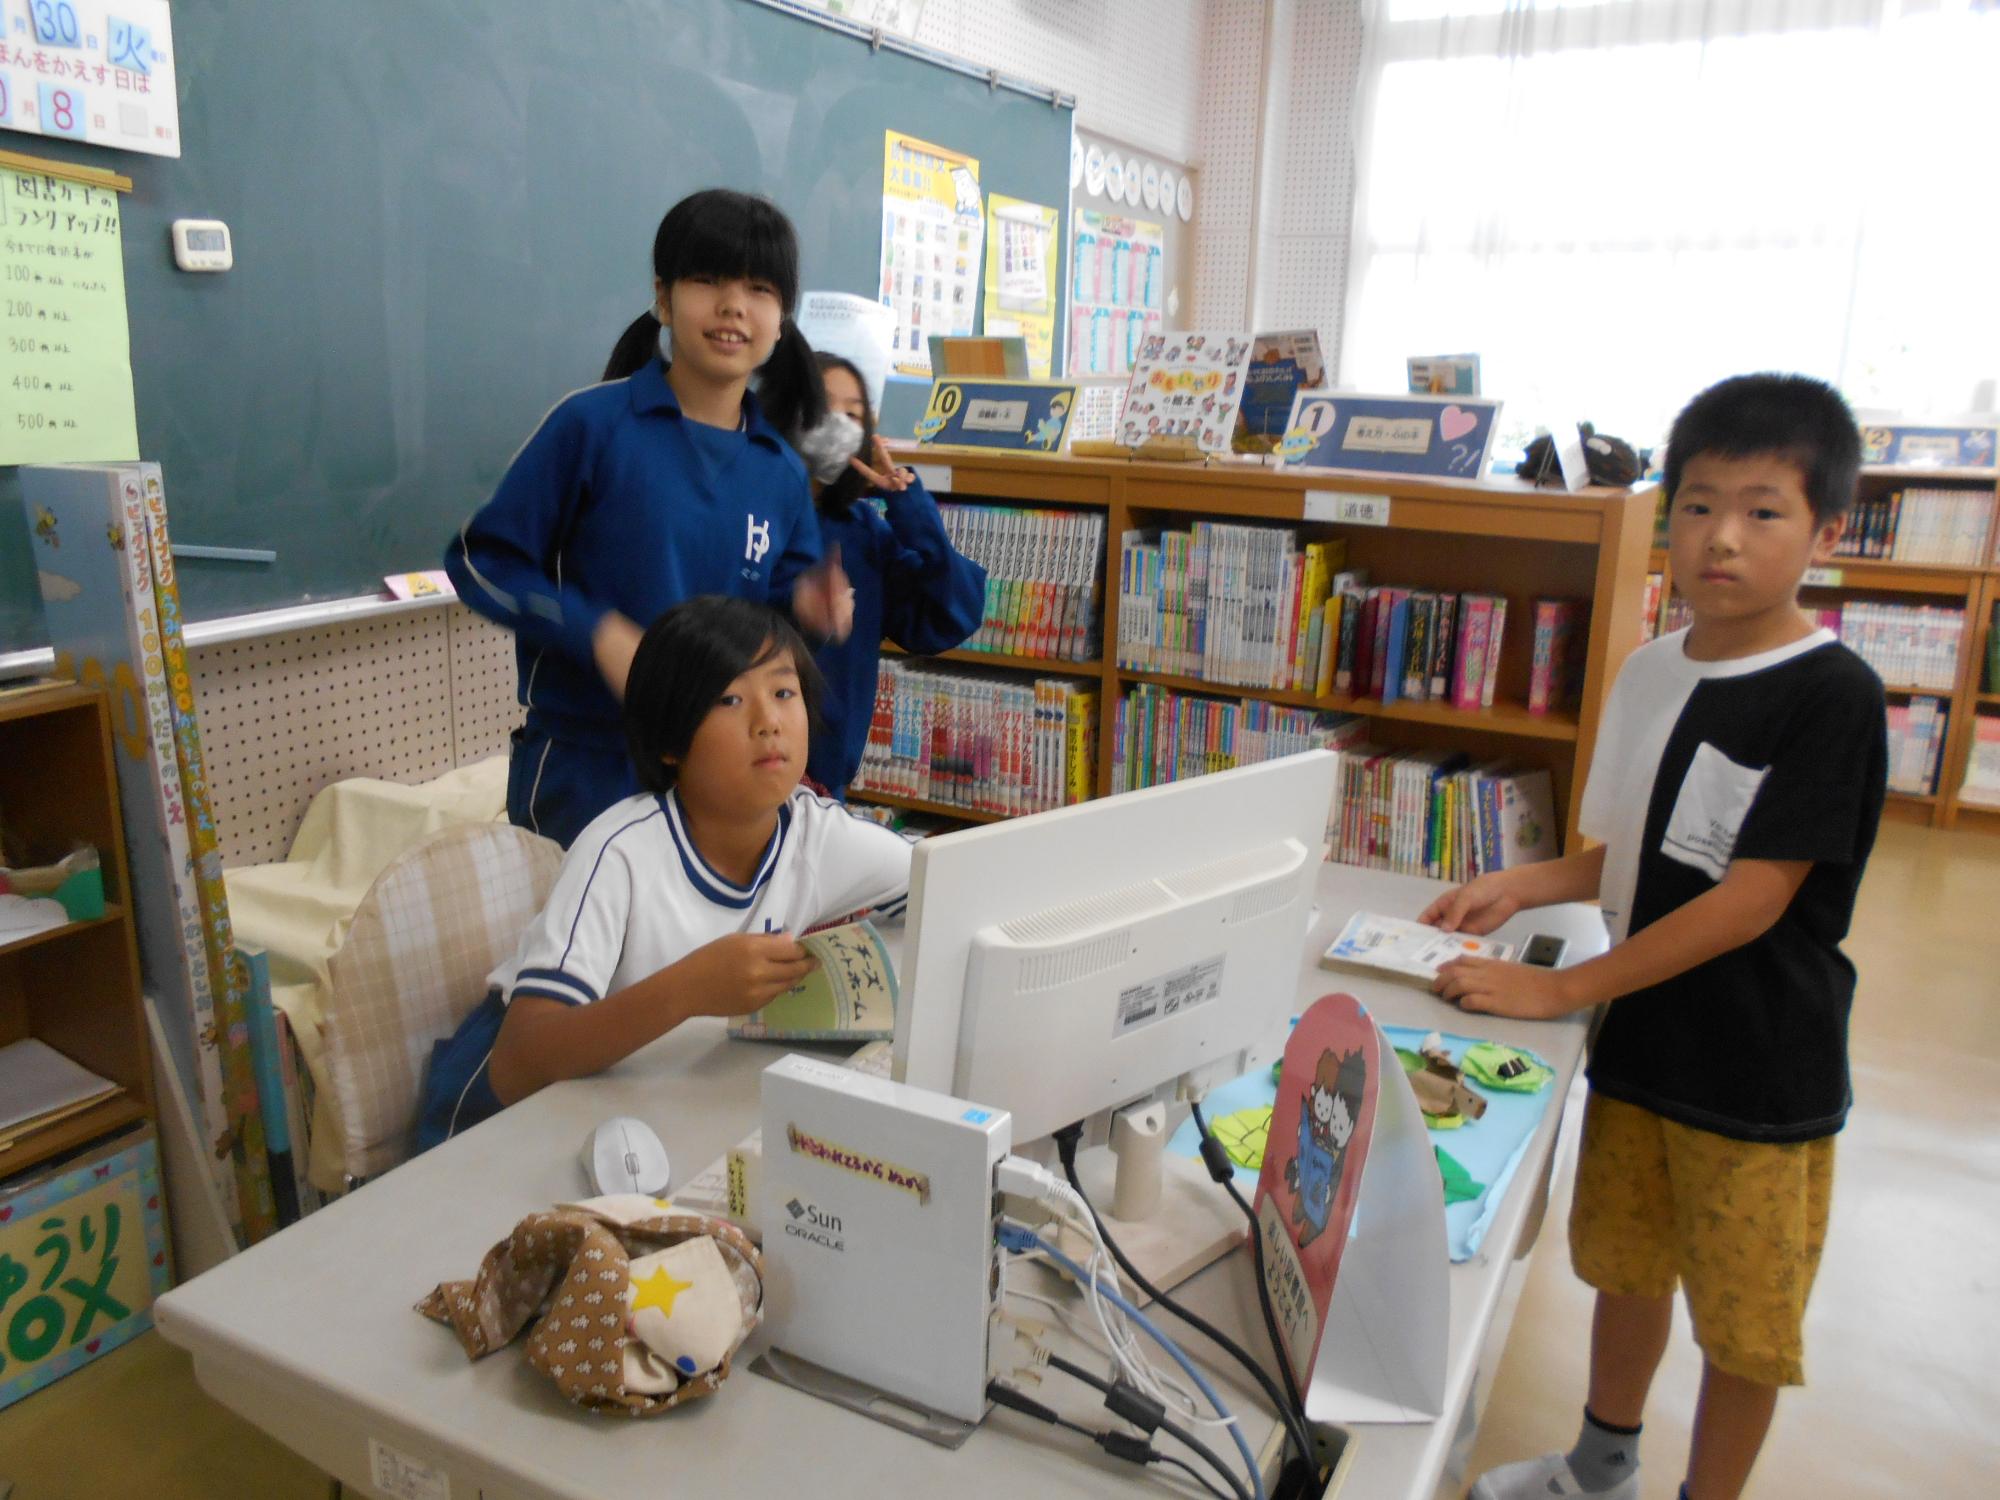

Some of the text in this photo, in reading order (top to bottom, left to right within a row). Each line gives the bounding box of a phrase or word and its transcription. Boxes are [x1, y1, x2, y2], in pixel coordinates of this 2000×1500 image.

[36, 1, 78, 43] 30
[114, 24, 148, 71] 火
[53, 90, 74, 131] 8
[942, 390, 957, 414] 0
[1310, 407, 1325, 431] 1
[139, 608, 184, 825] 100かいだてのいえ
[807, 1204, 843, 1233] Sun
[785, 1224, 845, 1251] ORACLE
[0, 1256, 131, 1376] OX
